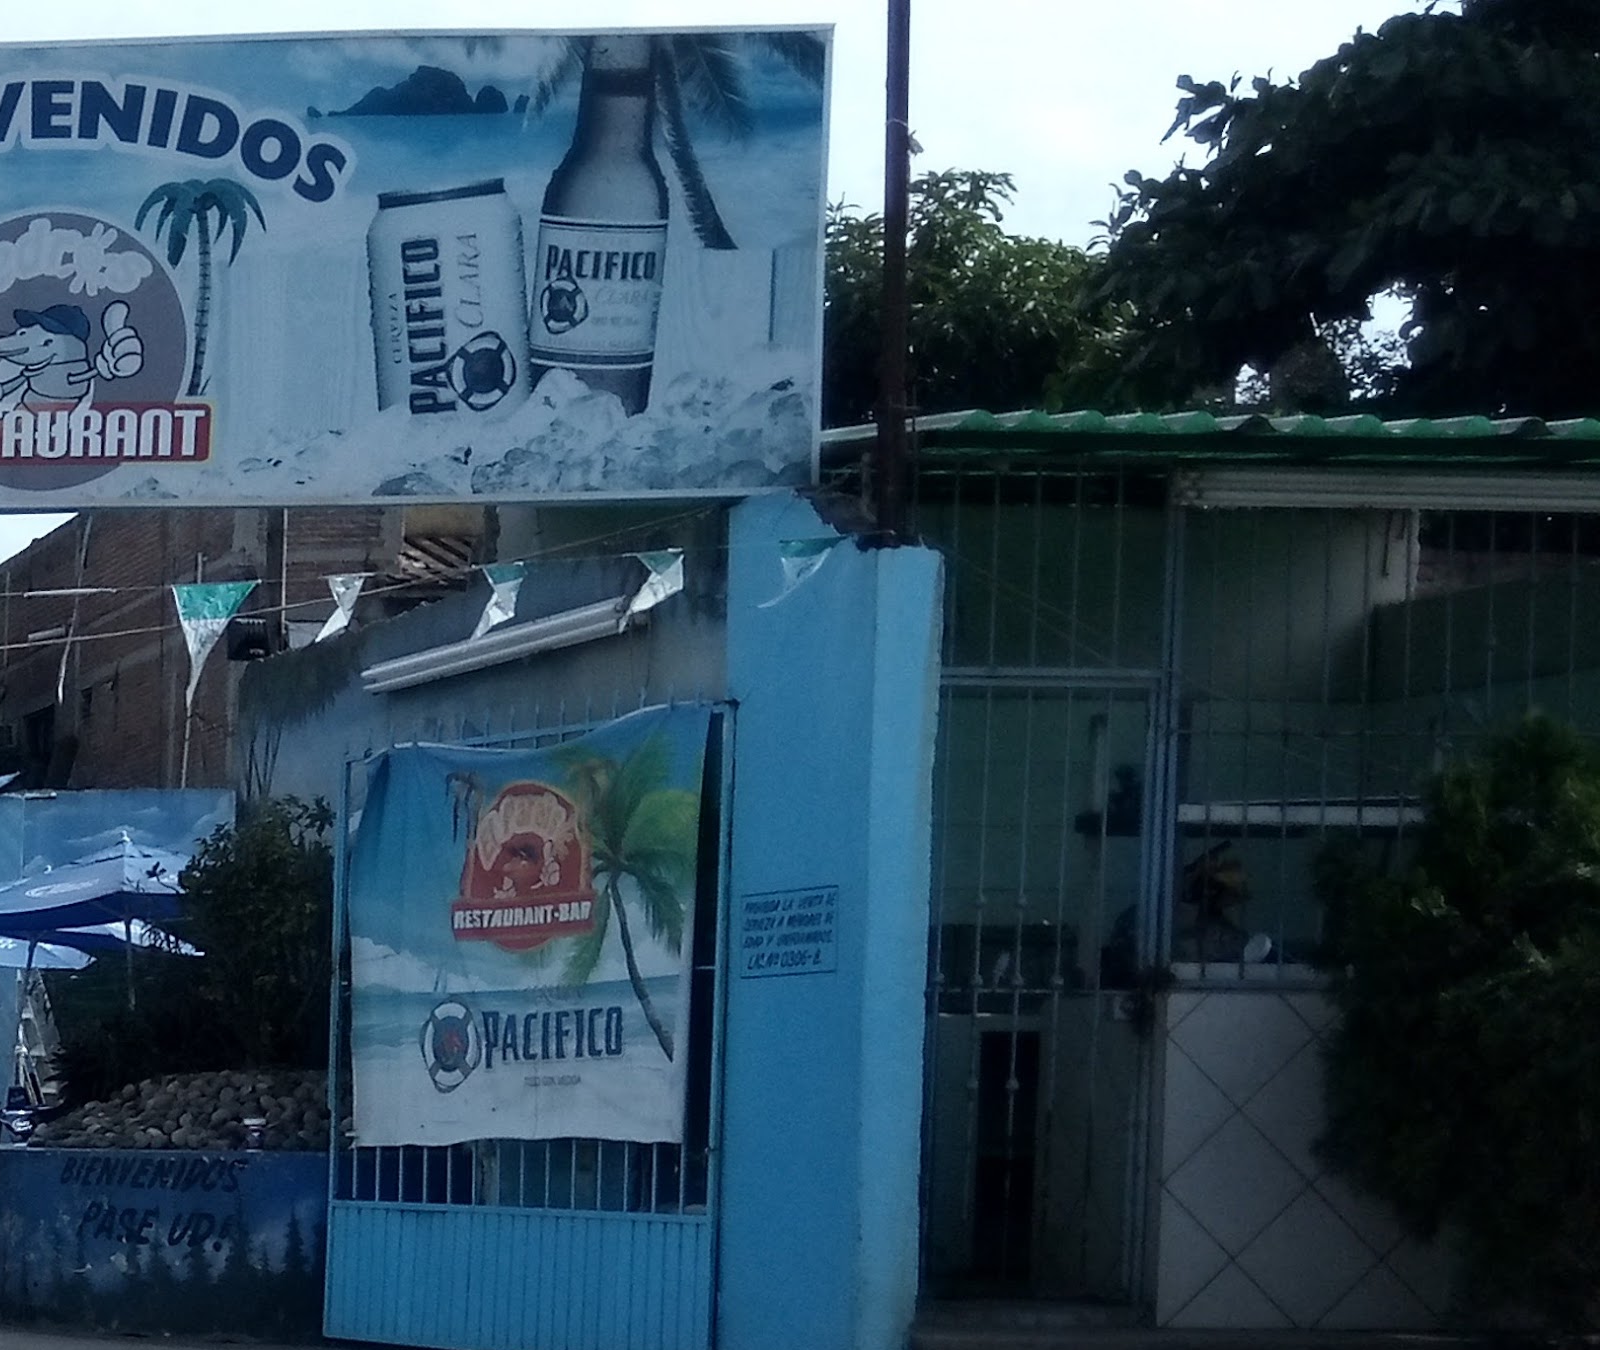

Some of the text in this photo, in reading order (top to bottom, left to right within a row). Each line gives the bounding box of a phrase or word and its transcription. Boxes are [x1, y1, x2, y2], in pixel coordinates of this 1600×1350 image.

[455, 232, 485, 329] CLARA
[545, 244, 657, 281] PACIFICO
[400, 238, 458, 415] PACIFICO
[481, 1005, 624, 1070] PACIFICO
[60, 1156, 248, 1193] BIENVENIDOS
[76, 1201, 159, 1246] PASE
